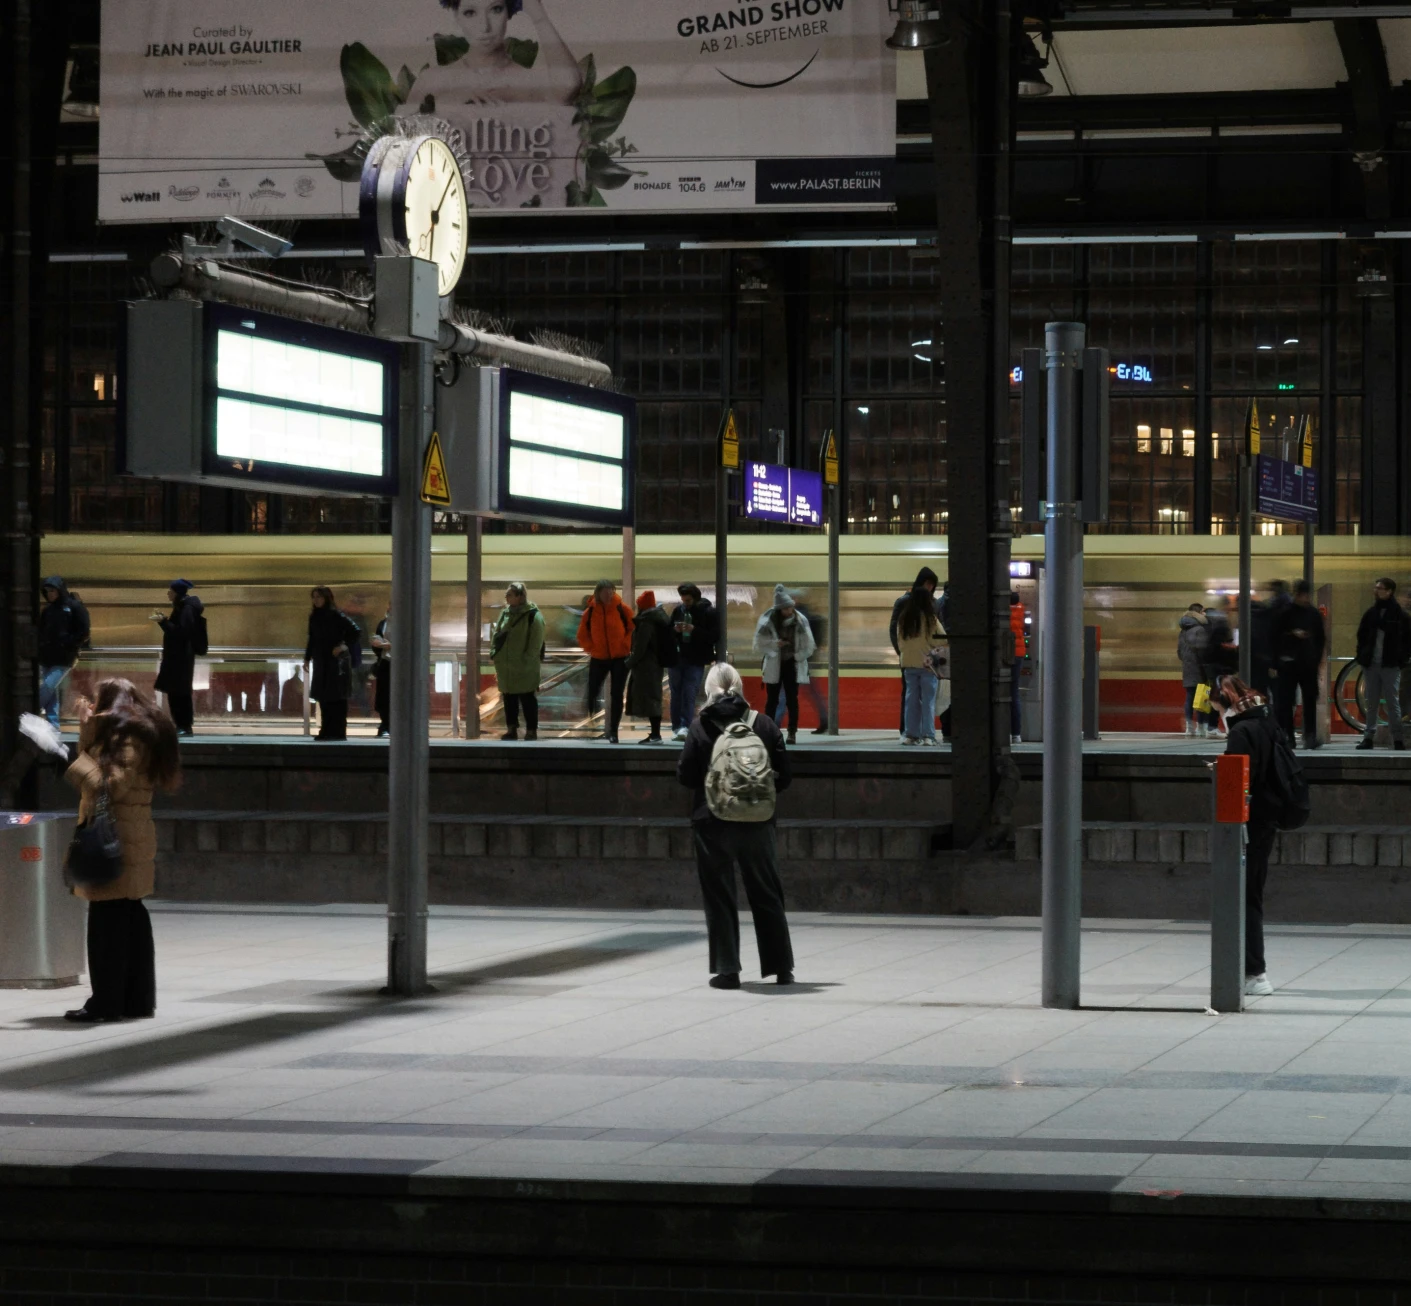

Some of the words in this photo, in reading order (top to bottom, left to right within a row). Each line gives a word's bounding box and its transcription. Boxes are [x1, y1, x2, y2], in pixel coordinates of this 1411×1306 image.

[676, 6, 764, 38] GRAND
[771, 0, 845, 22] SHOW
[192, 24, 236, 38] Curated
[239, 25, 254, 40] by
[699, 40, 720, 54] AB
[723, 35, 744, 51] 21.
[745, 20, 829, 47] SEPTEMBER
[144, 41, 184, 58] JEAN
[188, 40, 226, 56] PAUL
[229, 39, 302, 54] GAULTIER
[142, 88, 166, 99] With
[168, 87, 183, 98] the
[185, 87, 214, 100] magic
[217, 85, 228, 97] of
[230, 83, 302, 97] SWAROVSKI
[633, 181, 672, 191] BIONADE
[678, 182, 706, 194] 104.6
[769, 177, 882, 191] www.PALAST.BERLIN
